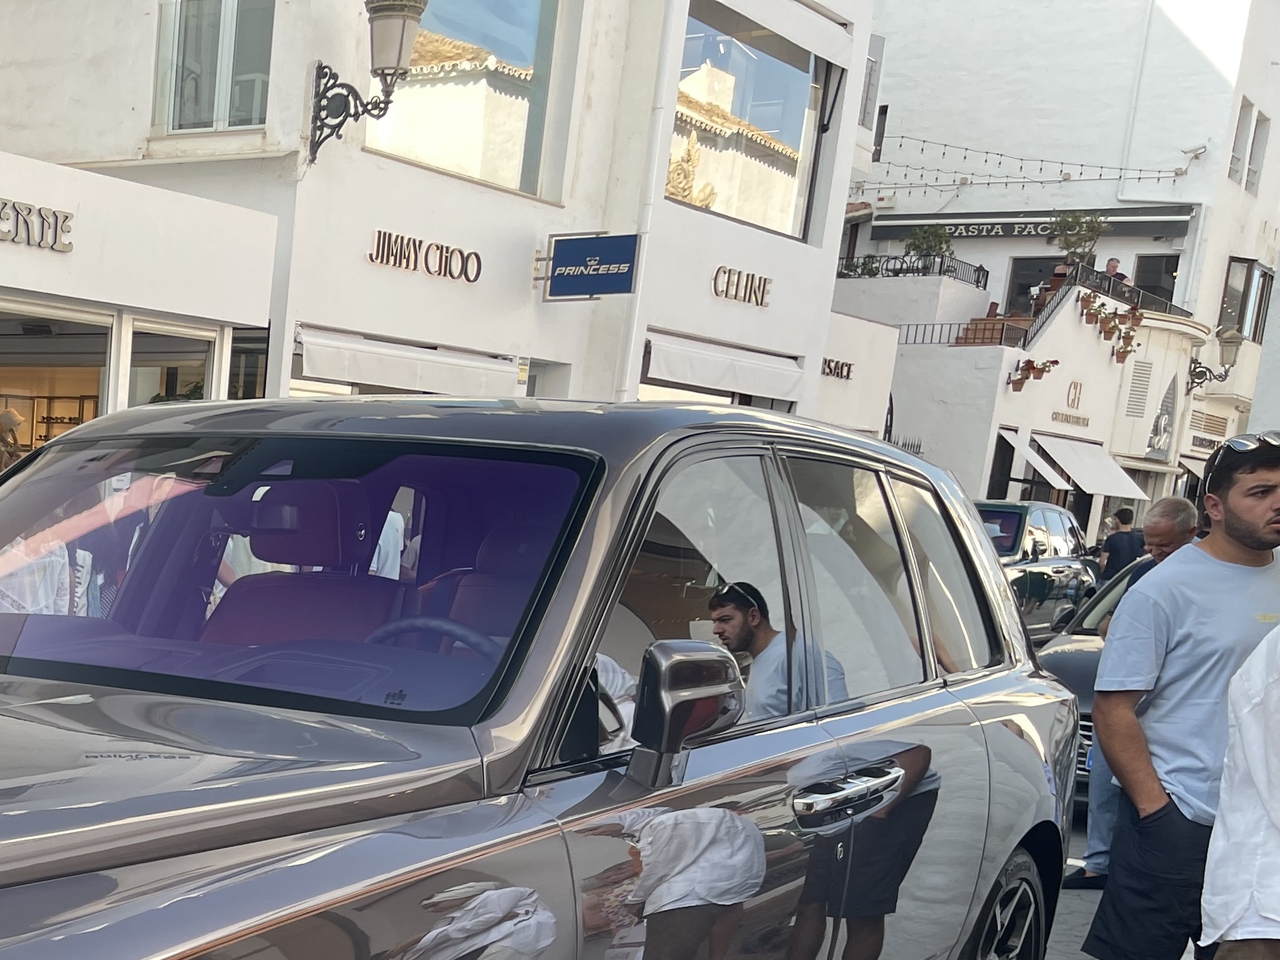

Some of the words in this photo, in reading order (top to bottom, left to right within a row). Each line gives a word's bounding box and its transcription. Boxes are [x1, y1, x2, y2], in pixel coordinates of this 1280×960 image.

[945, 224, 1004, 236] PASTA
[368, 229, 423, 272] JIMMY
[423, 241, 482, 283] CHOO
[554, 263, 631, 276] PRINCESS
[713, 265, 773, 307] CELINE
